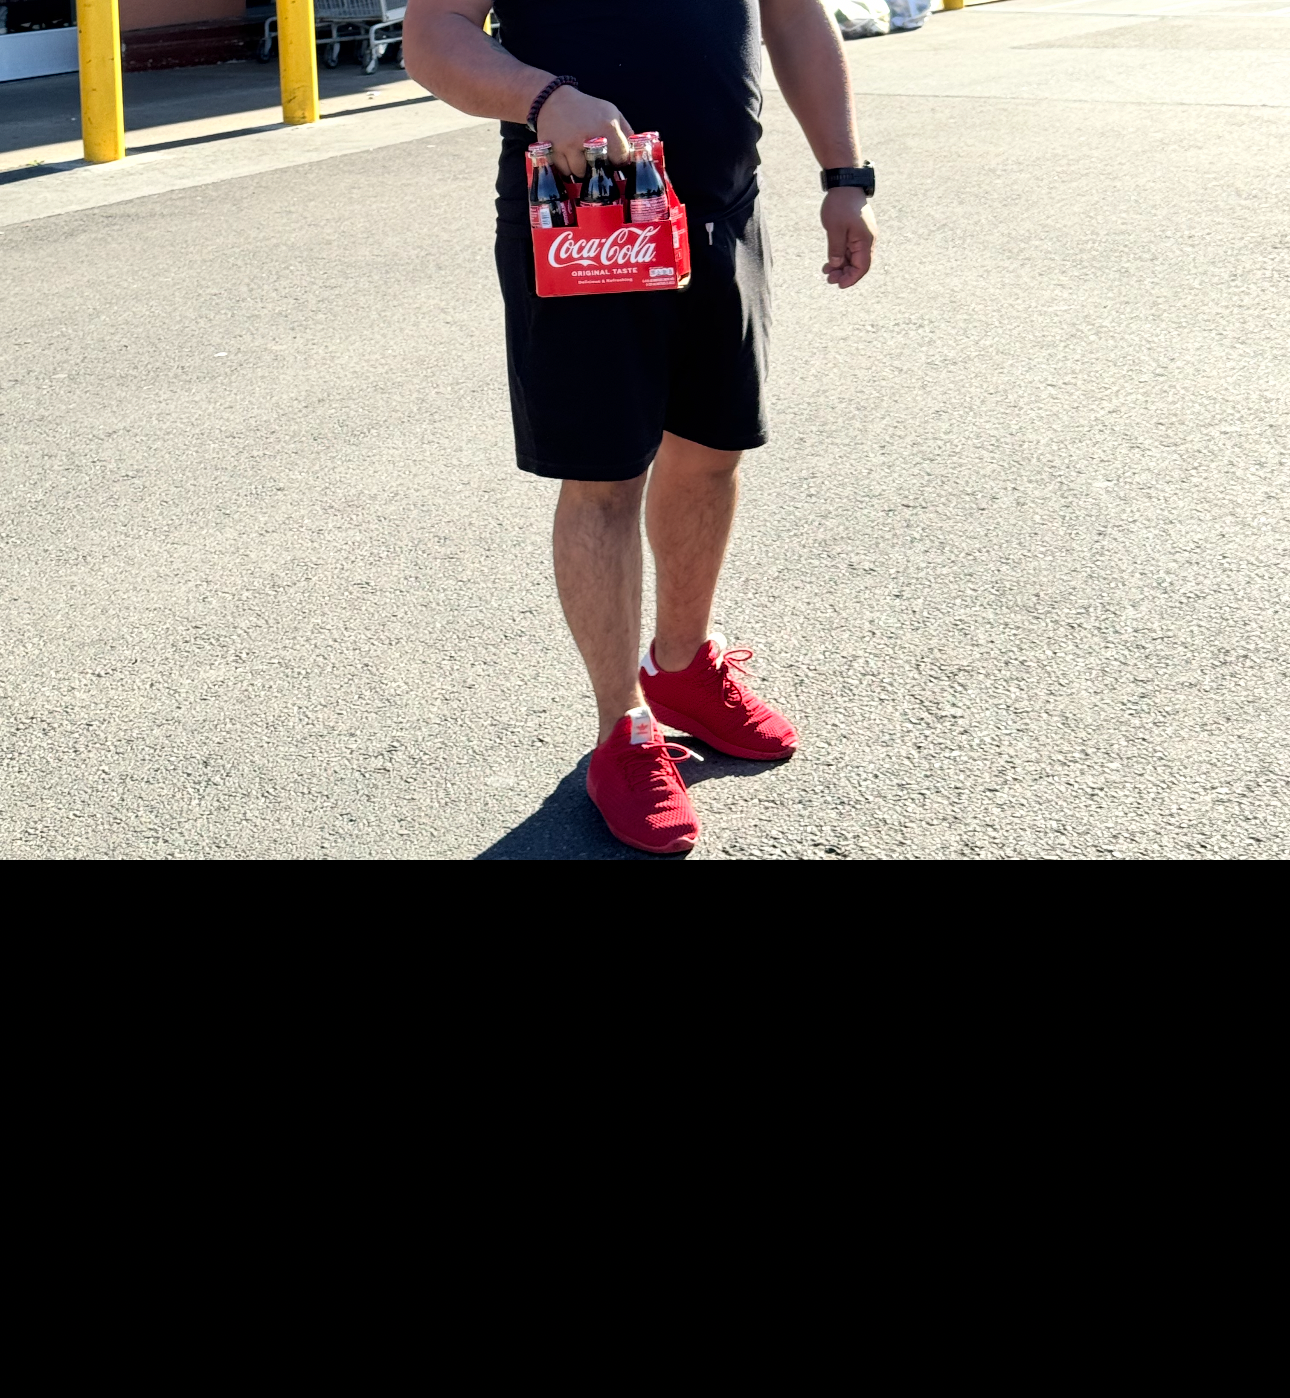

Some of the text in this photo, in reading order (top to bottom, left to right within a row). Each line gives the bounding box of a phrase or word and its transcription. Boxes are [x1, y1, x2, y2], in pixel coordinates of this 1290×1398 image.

[548, 225, 661, 267] Coca-Cola
[571, 267, 638, 277] ORIGINAL TASTE
